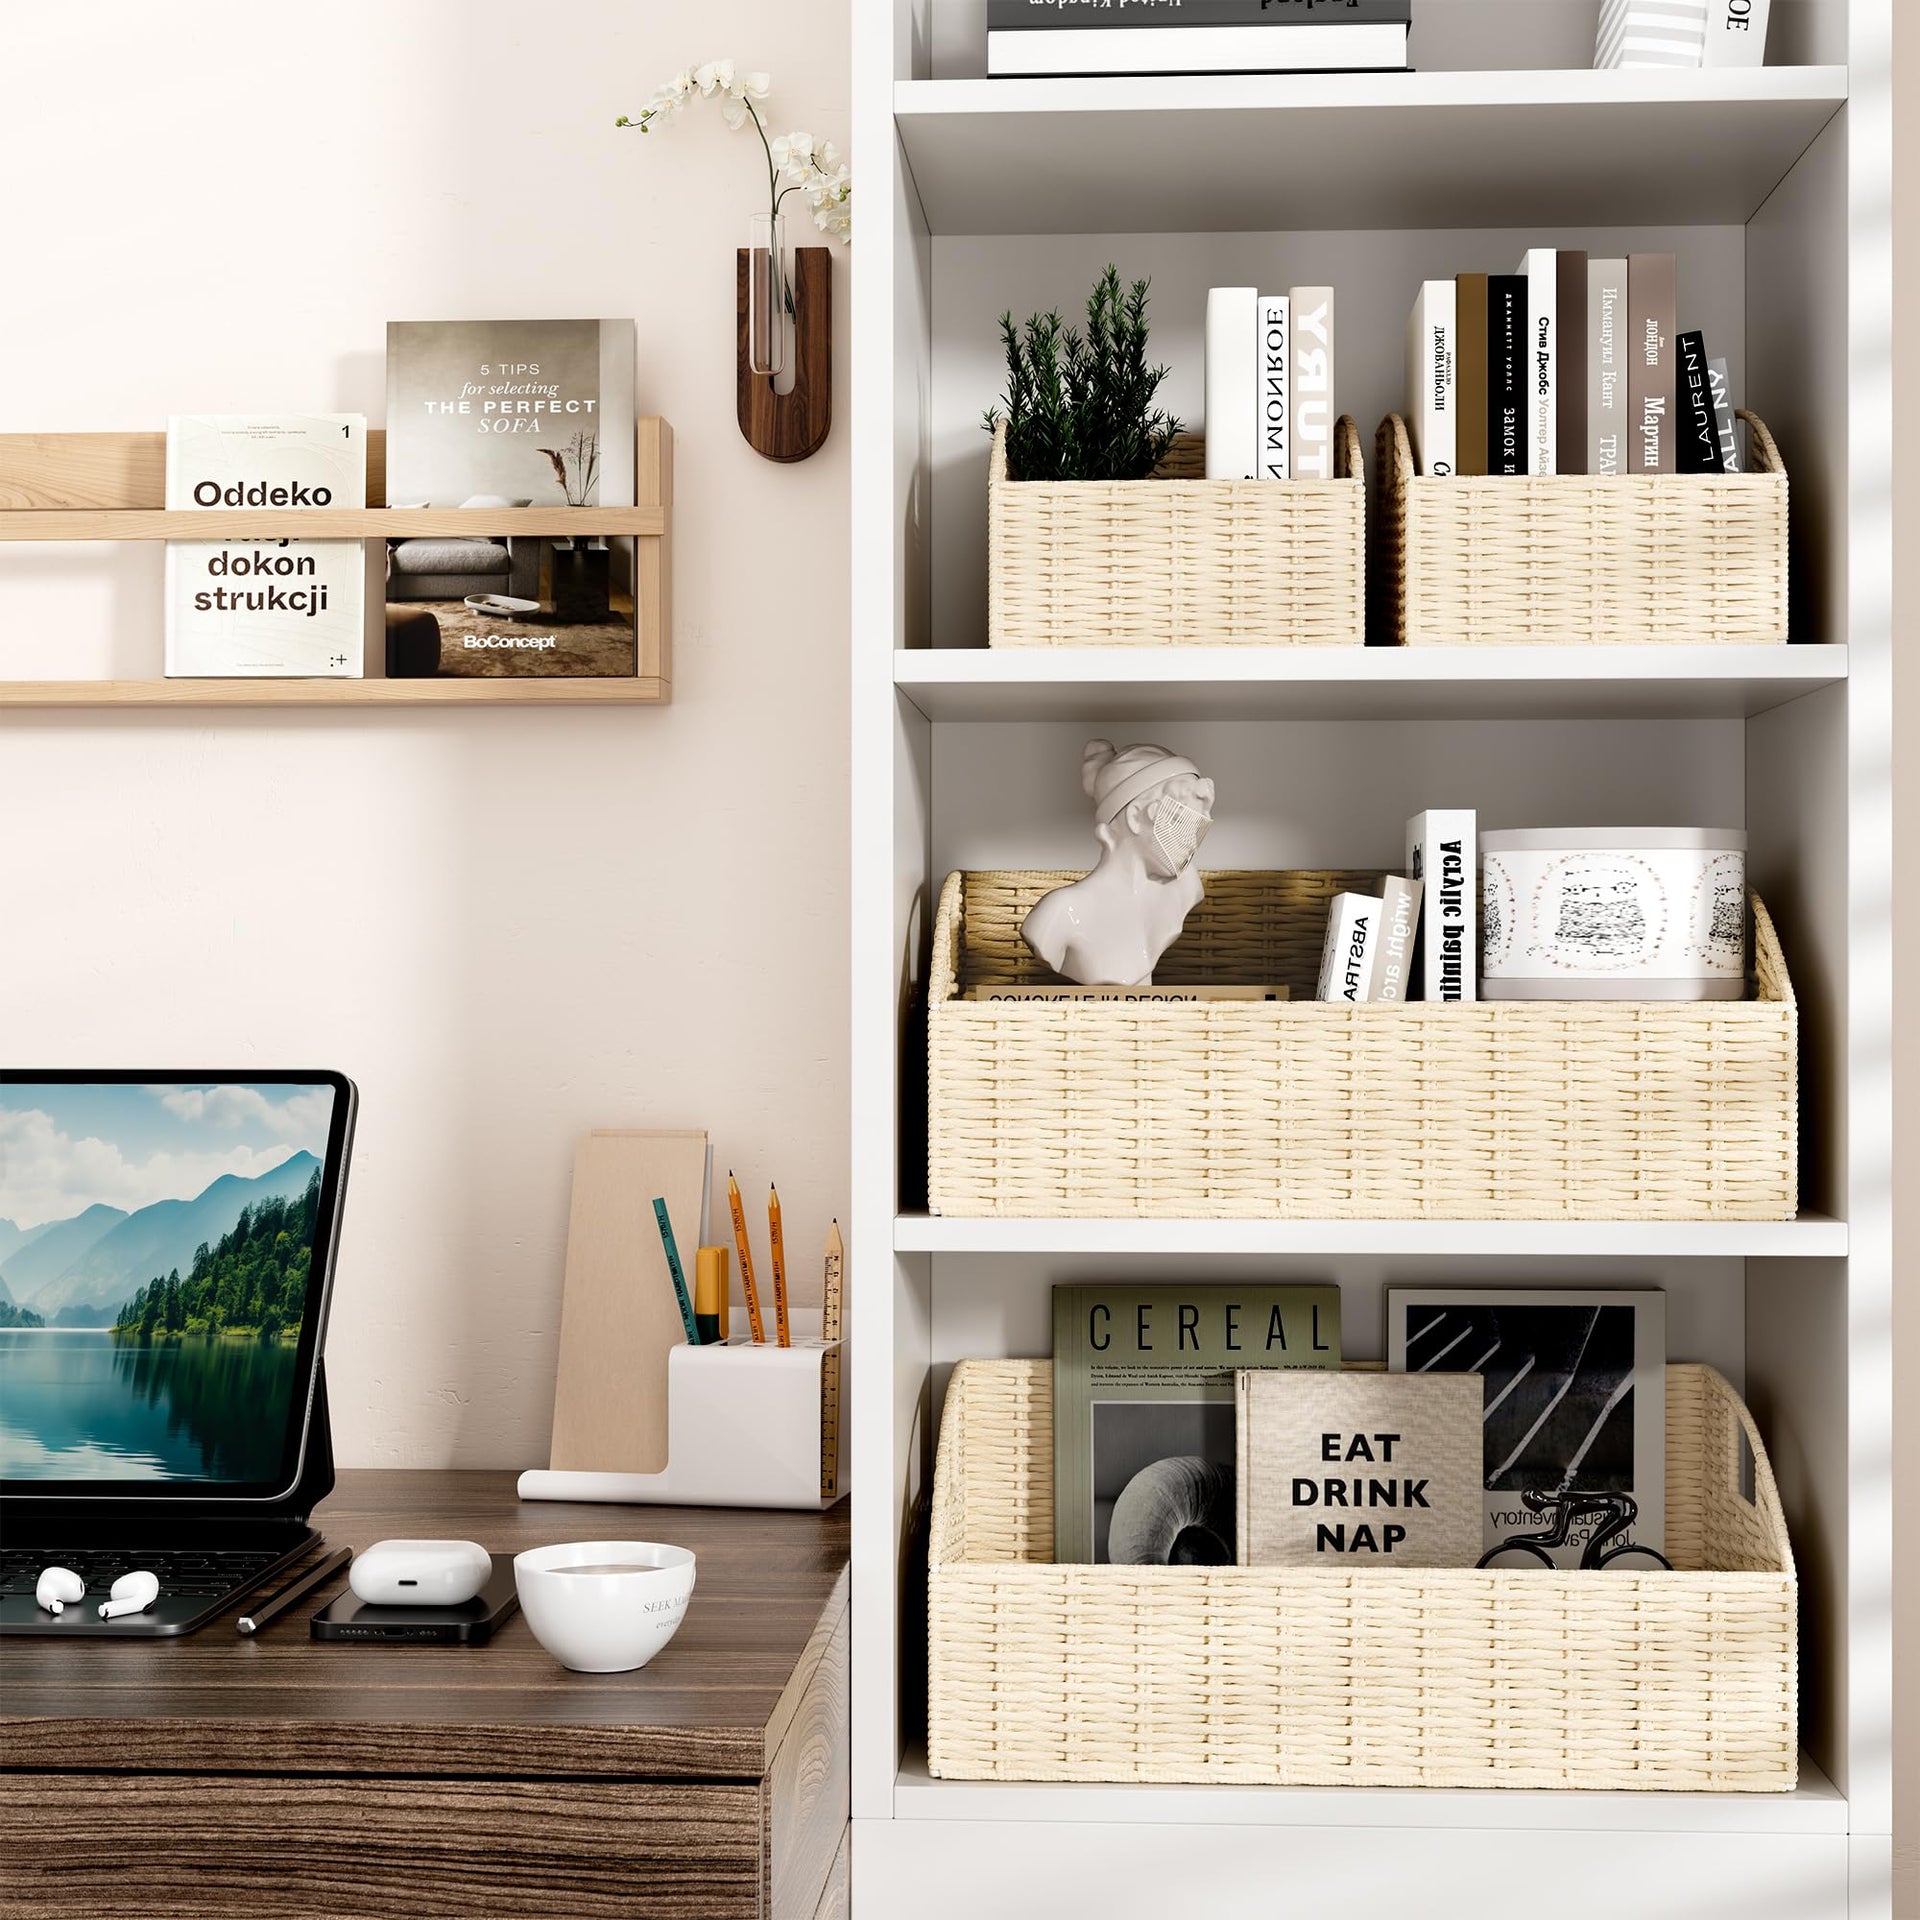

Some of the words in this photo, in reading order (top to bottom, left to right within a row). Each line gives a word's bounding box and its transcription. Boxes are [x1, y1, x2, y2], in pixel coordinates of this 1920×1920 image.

[1538, 316, 1550, 348] Стив
[1600, 288, 1617, 364] Иммануил
[480, 364, 490, 376] 5
[499, 363, 540, 376] TIPS
[1434, 326, 1445, 411] ДЖОВАНЬОЛИ
[1536, 351, 1550, 395] Джобс
[458, 382, 485, 399] for
[488, 382, 559, 398] selecting
[1602, 371, 1616, 409] Кант
[1682, 337, 1714, 462] LAURENT
[424, 401, 471, 414] THE
[483, 400, 596, 414] PERFECT
[1536, 398, 1549, 445] Уолтер
[341, 425, 350, 439] 1
[477, 418, 541, 433] SOFA
[1640, 396, 1665, 467] Мартин
[193, 481, 332, 507] Oddeko
[208, 550, 315, 576] dokon
[194, 585, 328, 617] strukcji
[463, 634, 556, 651] BoConcept
[1089, 1304, 1330, 1351] CEREAL
[1321, 1433, 1401, 1462] EAT
[1292, 1478, 1431, 1508] DRINK
[1316, 1524, 1406, 1553] NAP
